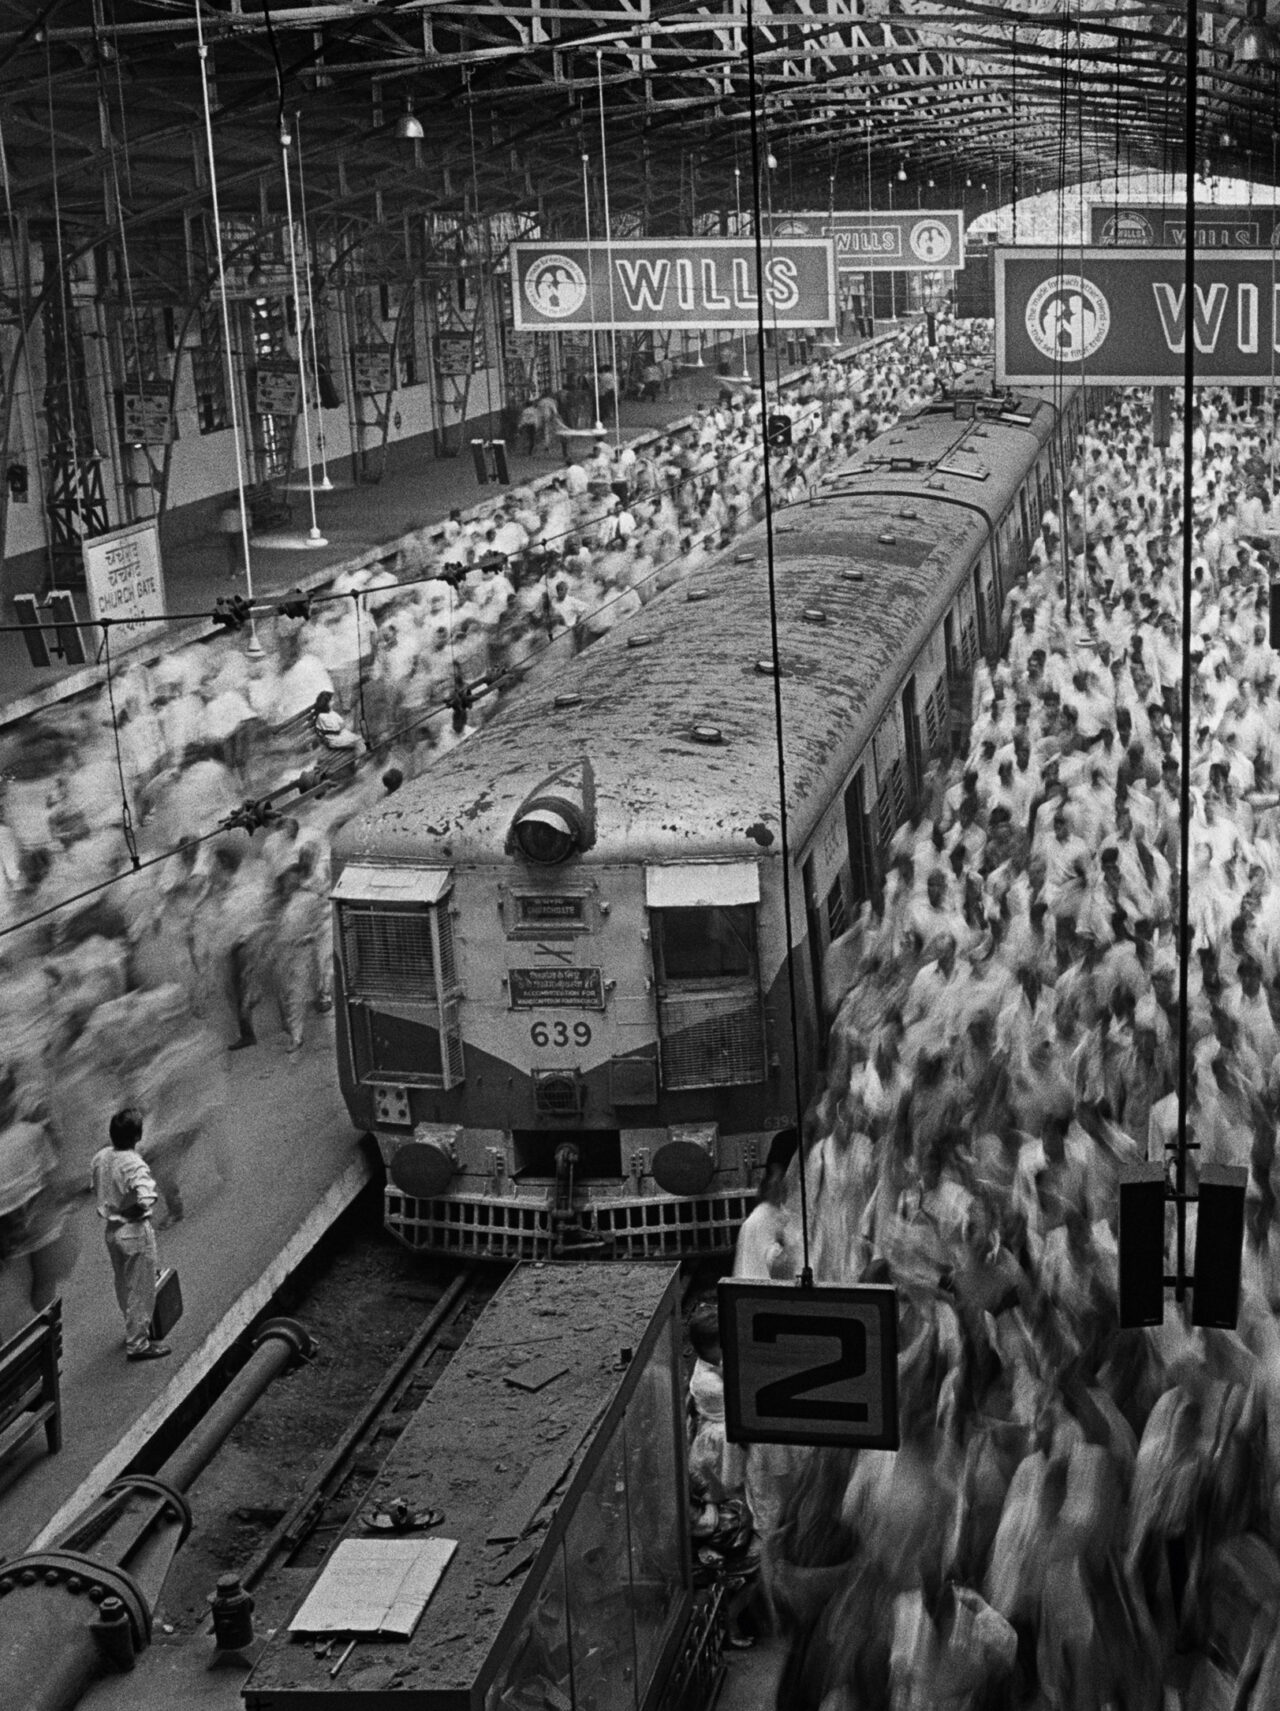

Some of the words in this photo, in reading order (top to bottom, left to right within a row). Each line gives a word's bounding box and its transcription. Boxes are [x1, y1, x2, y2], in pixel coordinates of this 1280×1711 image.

[615, 256, 799, 311] WILLS
[99, 583, 135, 613] CHURCH
[137, 577, 156, 598] GATE
[530, 1021, 592, 1047] 639
[753, 1313, 869, 1422] 2
